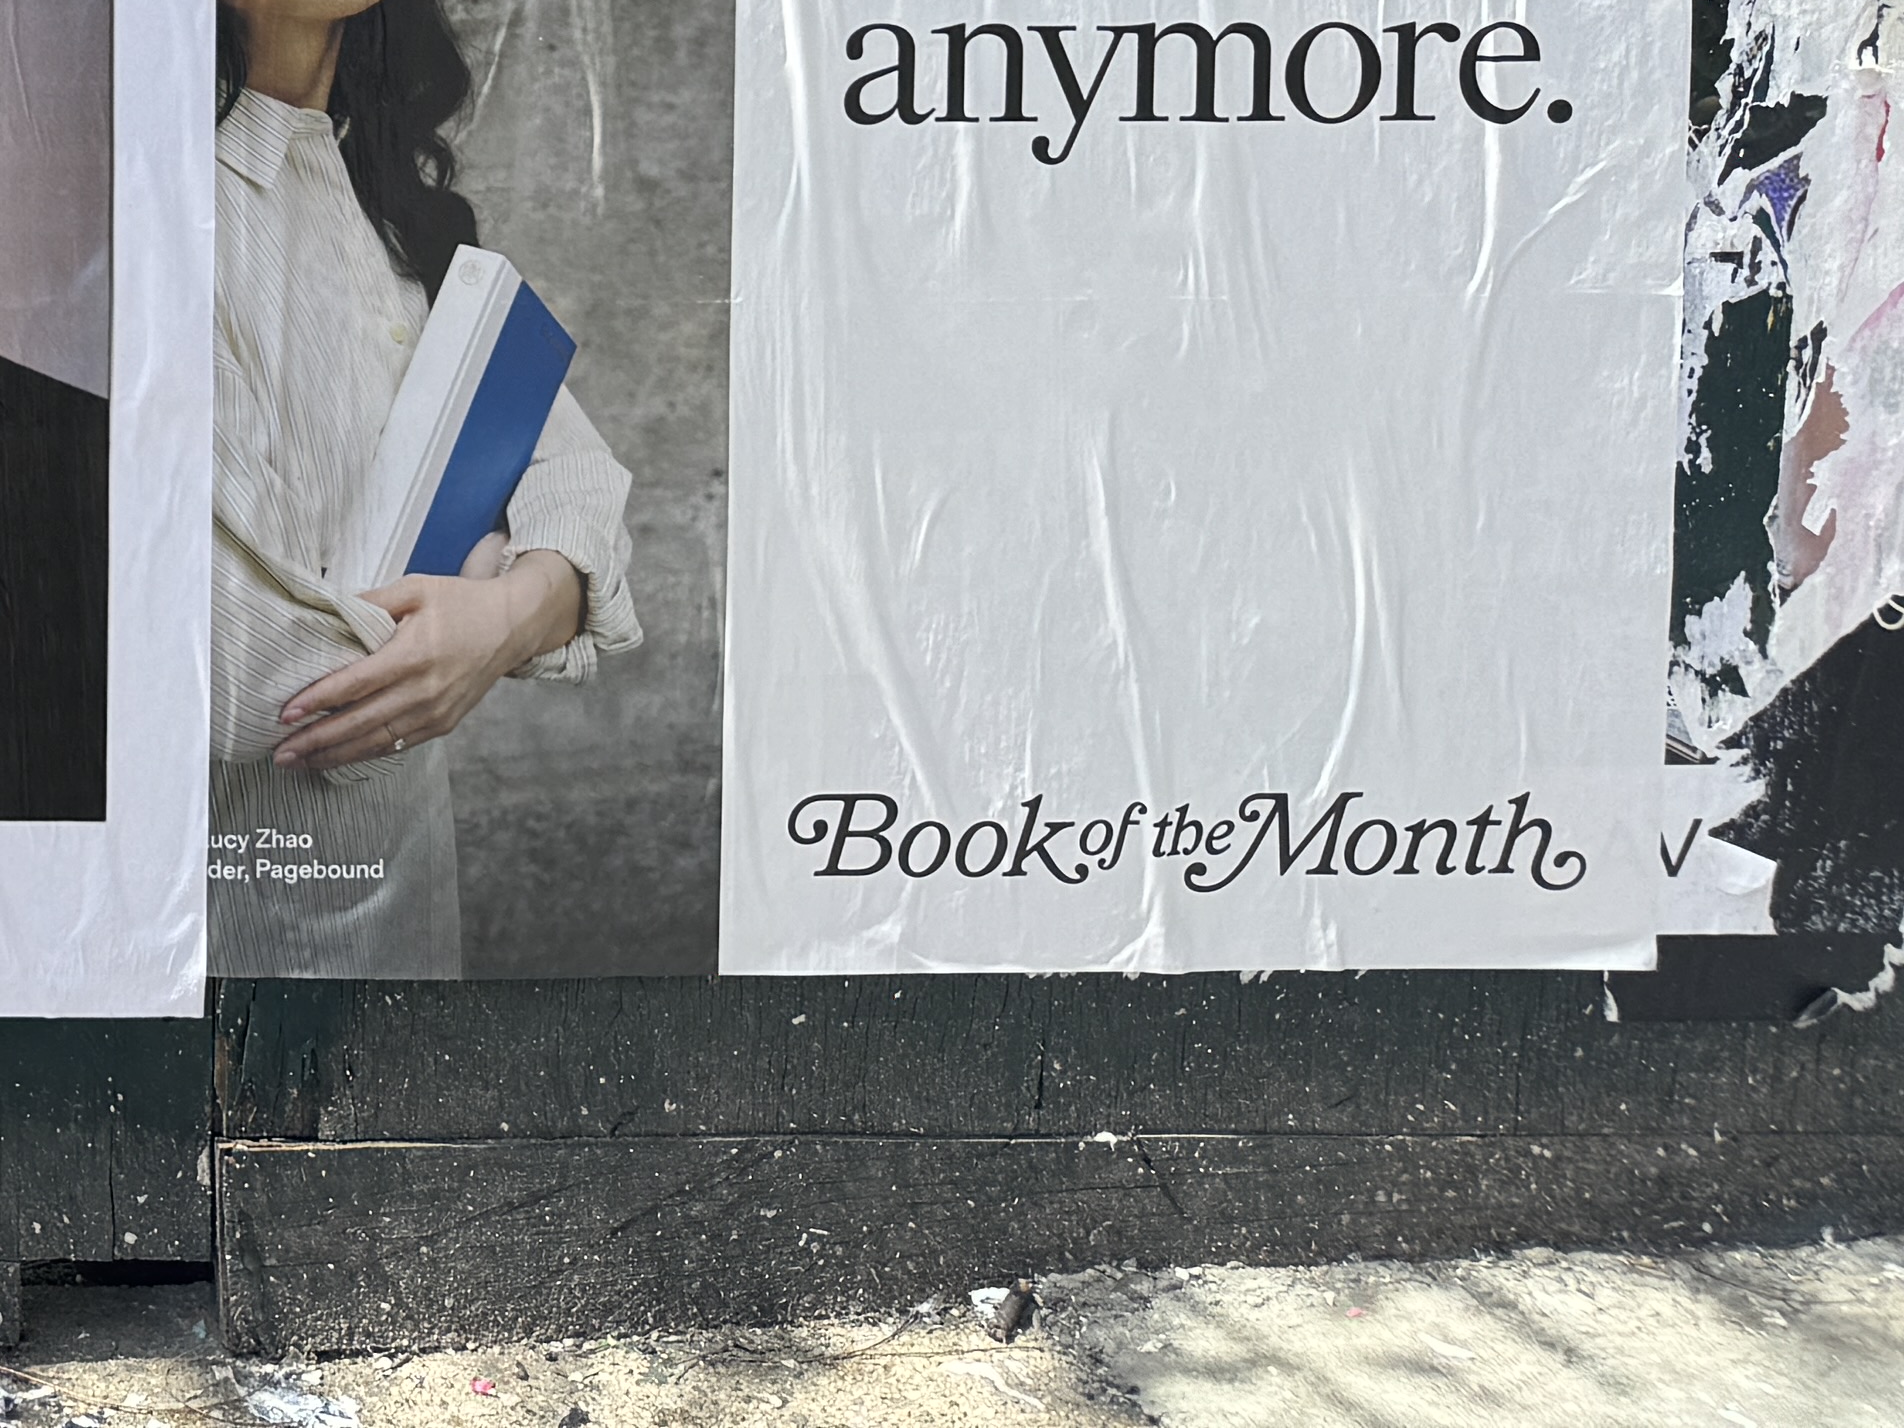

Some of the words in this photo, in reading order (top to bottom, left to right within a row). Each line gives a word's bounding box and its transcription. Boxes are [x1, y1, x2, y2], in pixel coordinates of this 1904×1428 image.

[843, 20, 1574, 165] anymore.
[208, 834, 249, 853] ucy
[256, 829, 313, 848] Zhao
[787, 793, 1089, 885] Book
[1079, 801, 1147, 870] of
[1152, 803, 1235, 857] the
[1183, 791, 1588, 893] Month
[256, 859, 384, 884] Pagebound
